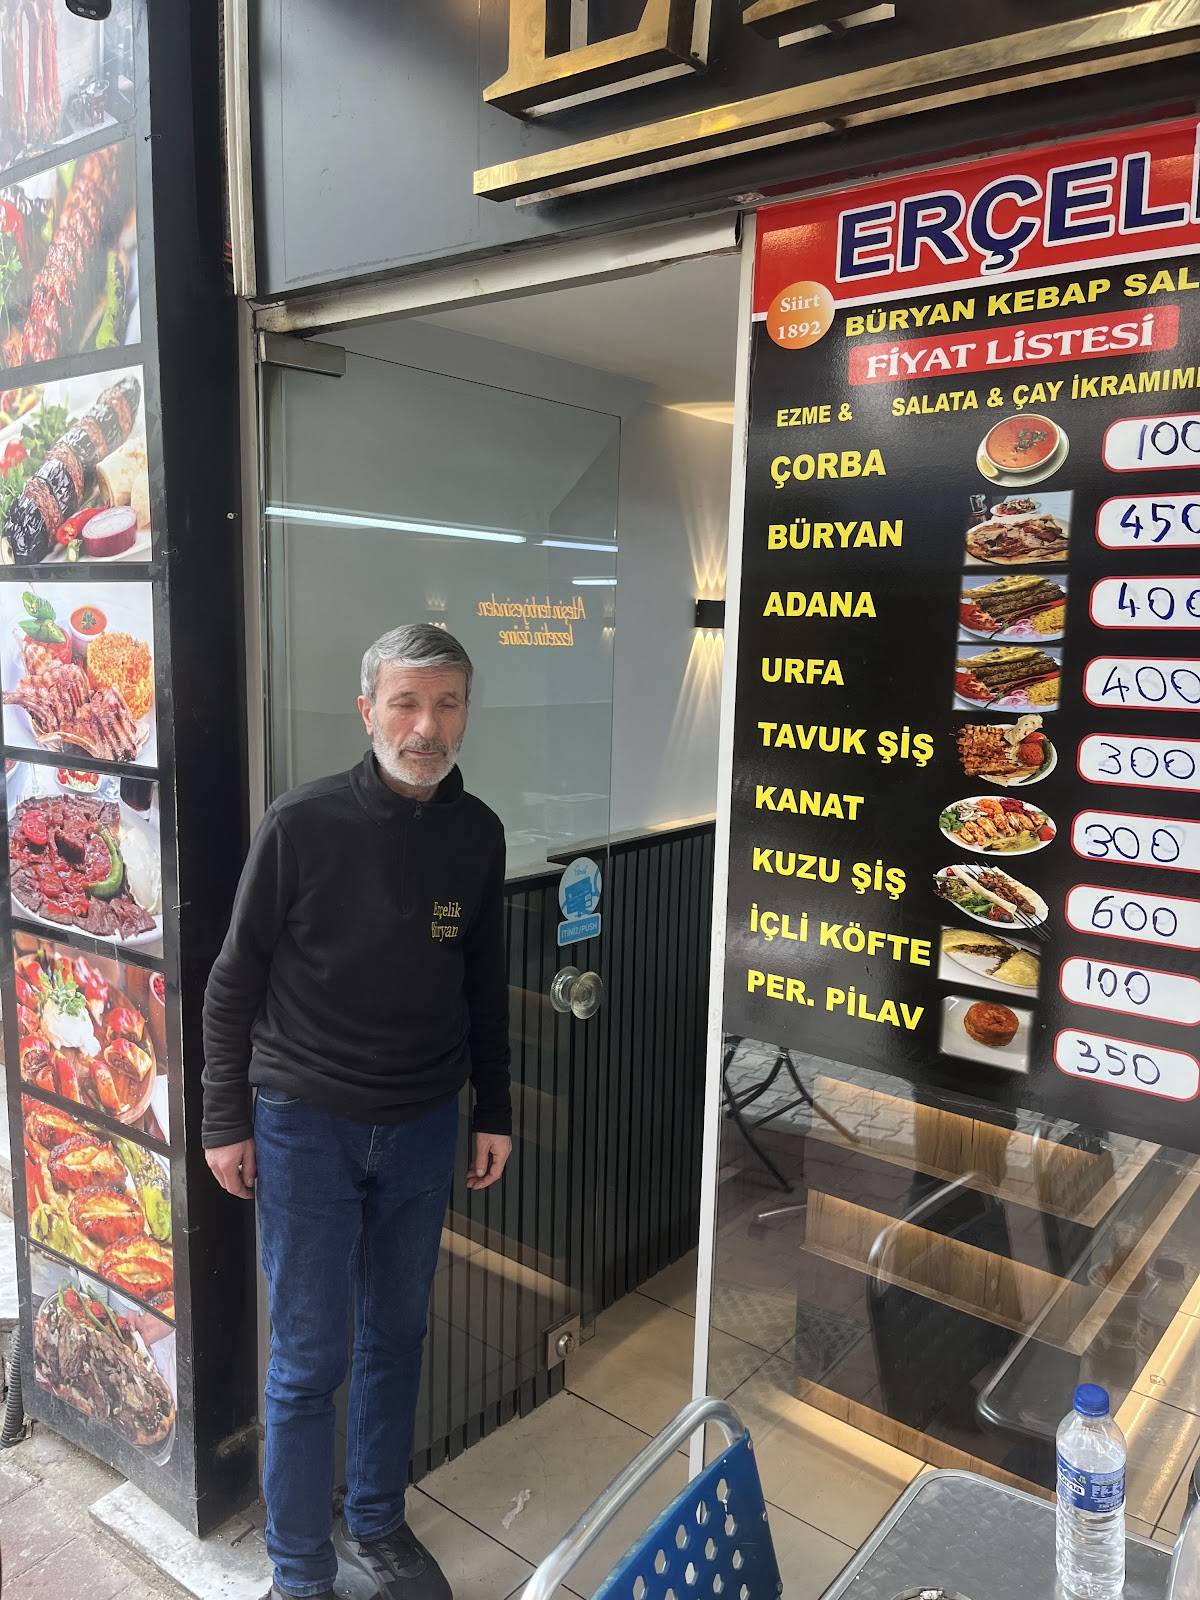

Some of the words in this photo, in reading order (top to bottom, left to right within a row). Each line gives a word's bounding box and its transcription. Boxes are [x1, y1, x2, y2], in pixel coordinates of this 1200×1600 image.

[836, 123, 1200, 284] ERÇEL
[780, 294, 821, 313] Siirt
[845, 299, 975, 337] BÜRYAN
[987, 278, 1112, 317] KEBAP
[777, 320, 822, 340] 1892
[866, 343, 977, 379] FİYAT
[985, 313, 1155, 365] LİSTESİ
[776, 406, 832, 428] EZME
[837, 404, 853, 421] &
[891, 391, 979, 417] SALATA
[988, 387, 1005, 408] &
[1013, 381, 1064, 410] ÇAY
[1137, 421, 1200, 460] 100
[769, 449, 887, 489] ÇORBA
[767, 518, 904, 550] BÜRYAN
[762, 591, 878, 618] ADANA
[760, 657, 845, 686] URFA
[1101, 666, 1200, 704] 400
[757, 721, 866, 755] TAVUK
[876, 725, 935, 768] ŞİŞ
[1098, 742, 1196, 780] 300
[755, 785, 864, 821] KANAT
[1085, 824, 1180, 862] 300
[752, 847, 841, 884] KUZU
[851, 859, 907, 900] ŞİŞ
[749, 903, 808, 944] İÇLİ
[819, 921, 931, 967] KÖFTE
[1092, 896, 1178, 937] 600
[747, 970, 815, 1007] PER.
[825, 984, 924, 1032] PİLAV
[1086, 961, 1151, 1005] 100
[1076, 1039, 1161, 1086] 350
